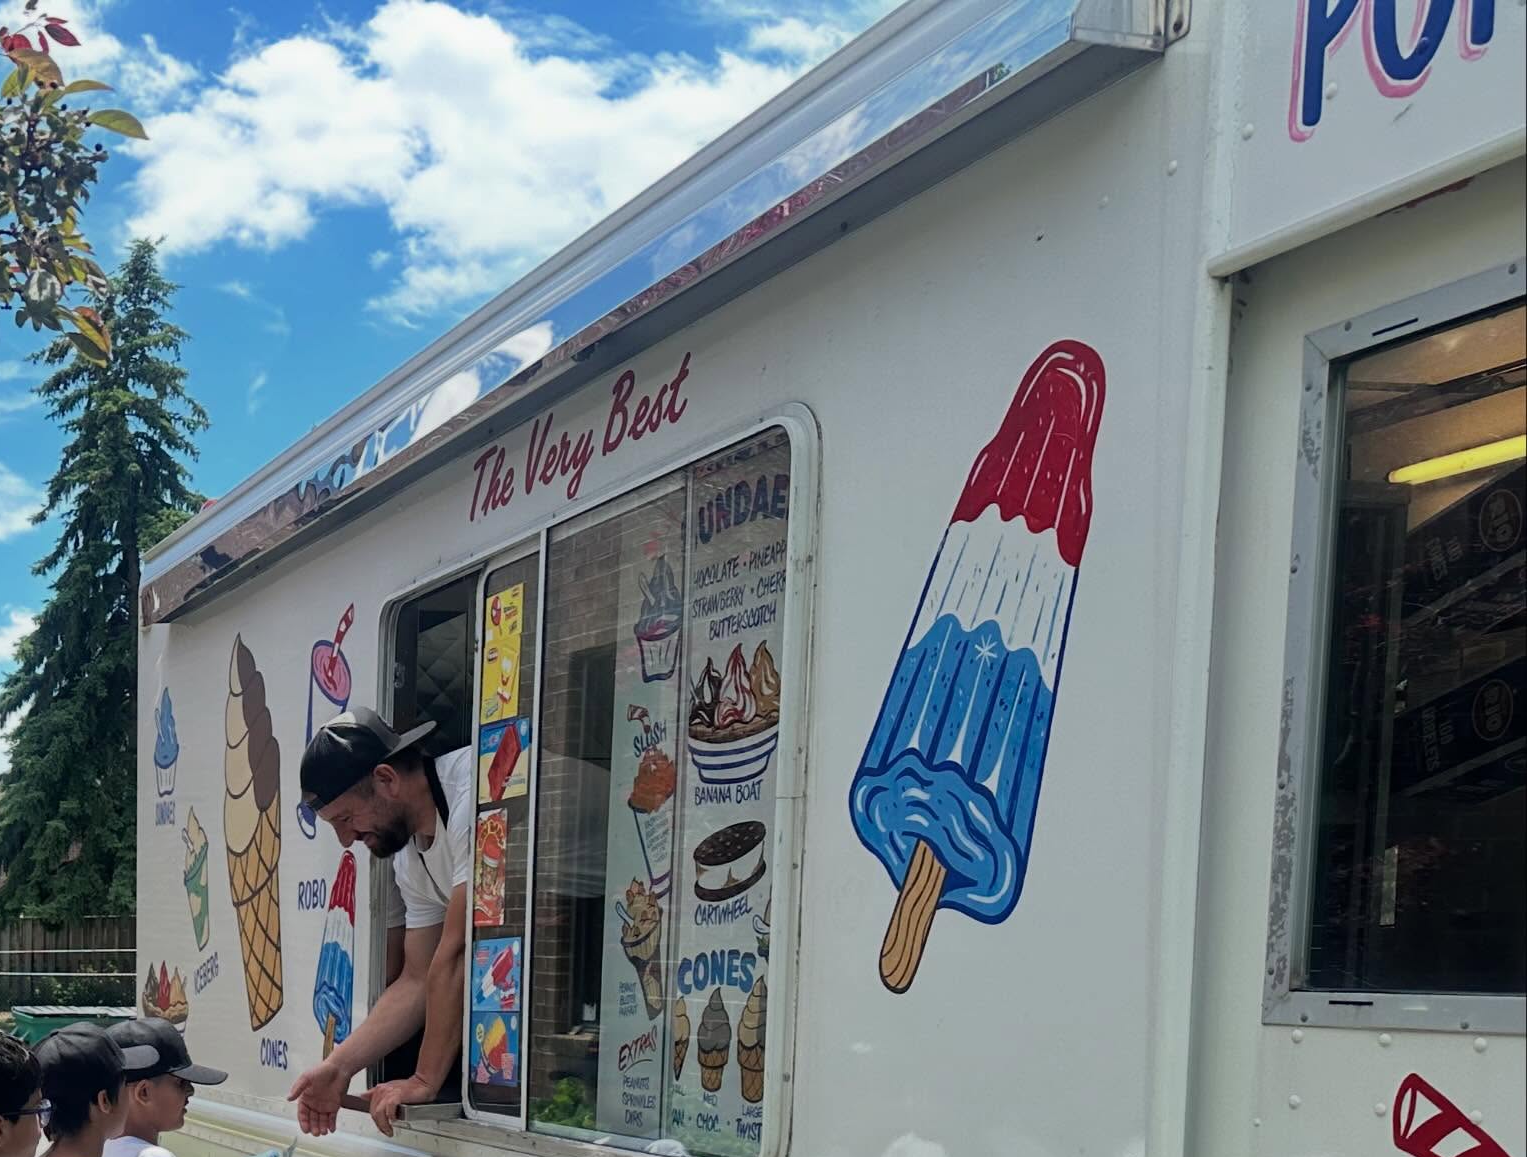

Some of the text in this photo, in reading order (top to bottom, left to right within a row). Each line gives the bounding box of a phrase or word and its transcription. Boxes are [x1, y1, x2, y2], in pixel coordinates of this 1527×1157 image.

[469, 351, 692, 522] The Very Best
[696, 474, 790, 548] UNDAE
[709, 599, 777, 640] BUTTERSCOTCH
[694, 778, 763, 806] BANANA BOAT
[298, 878, 326, 911] ROBO
[694, 894, 752, 926] CARTWHEEL
[193, 951, 219, 996] ICEBERG
[677, 948, 757, 995] CONES
[260, 1037, 288, 1071] CONES
[618, 1025, 658, 1071] EXTRAS
[741, 1103, 763, 1119] LARGE
[735, 1117, 763, 1143] TWIST
